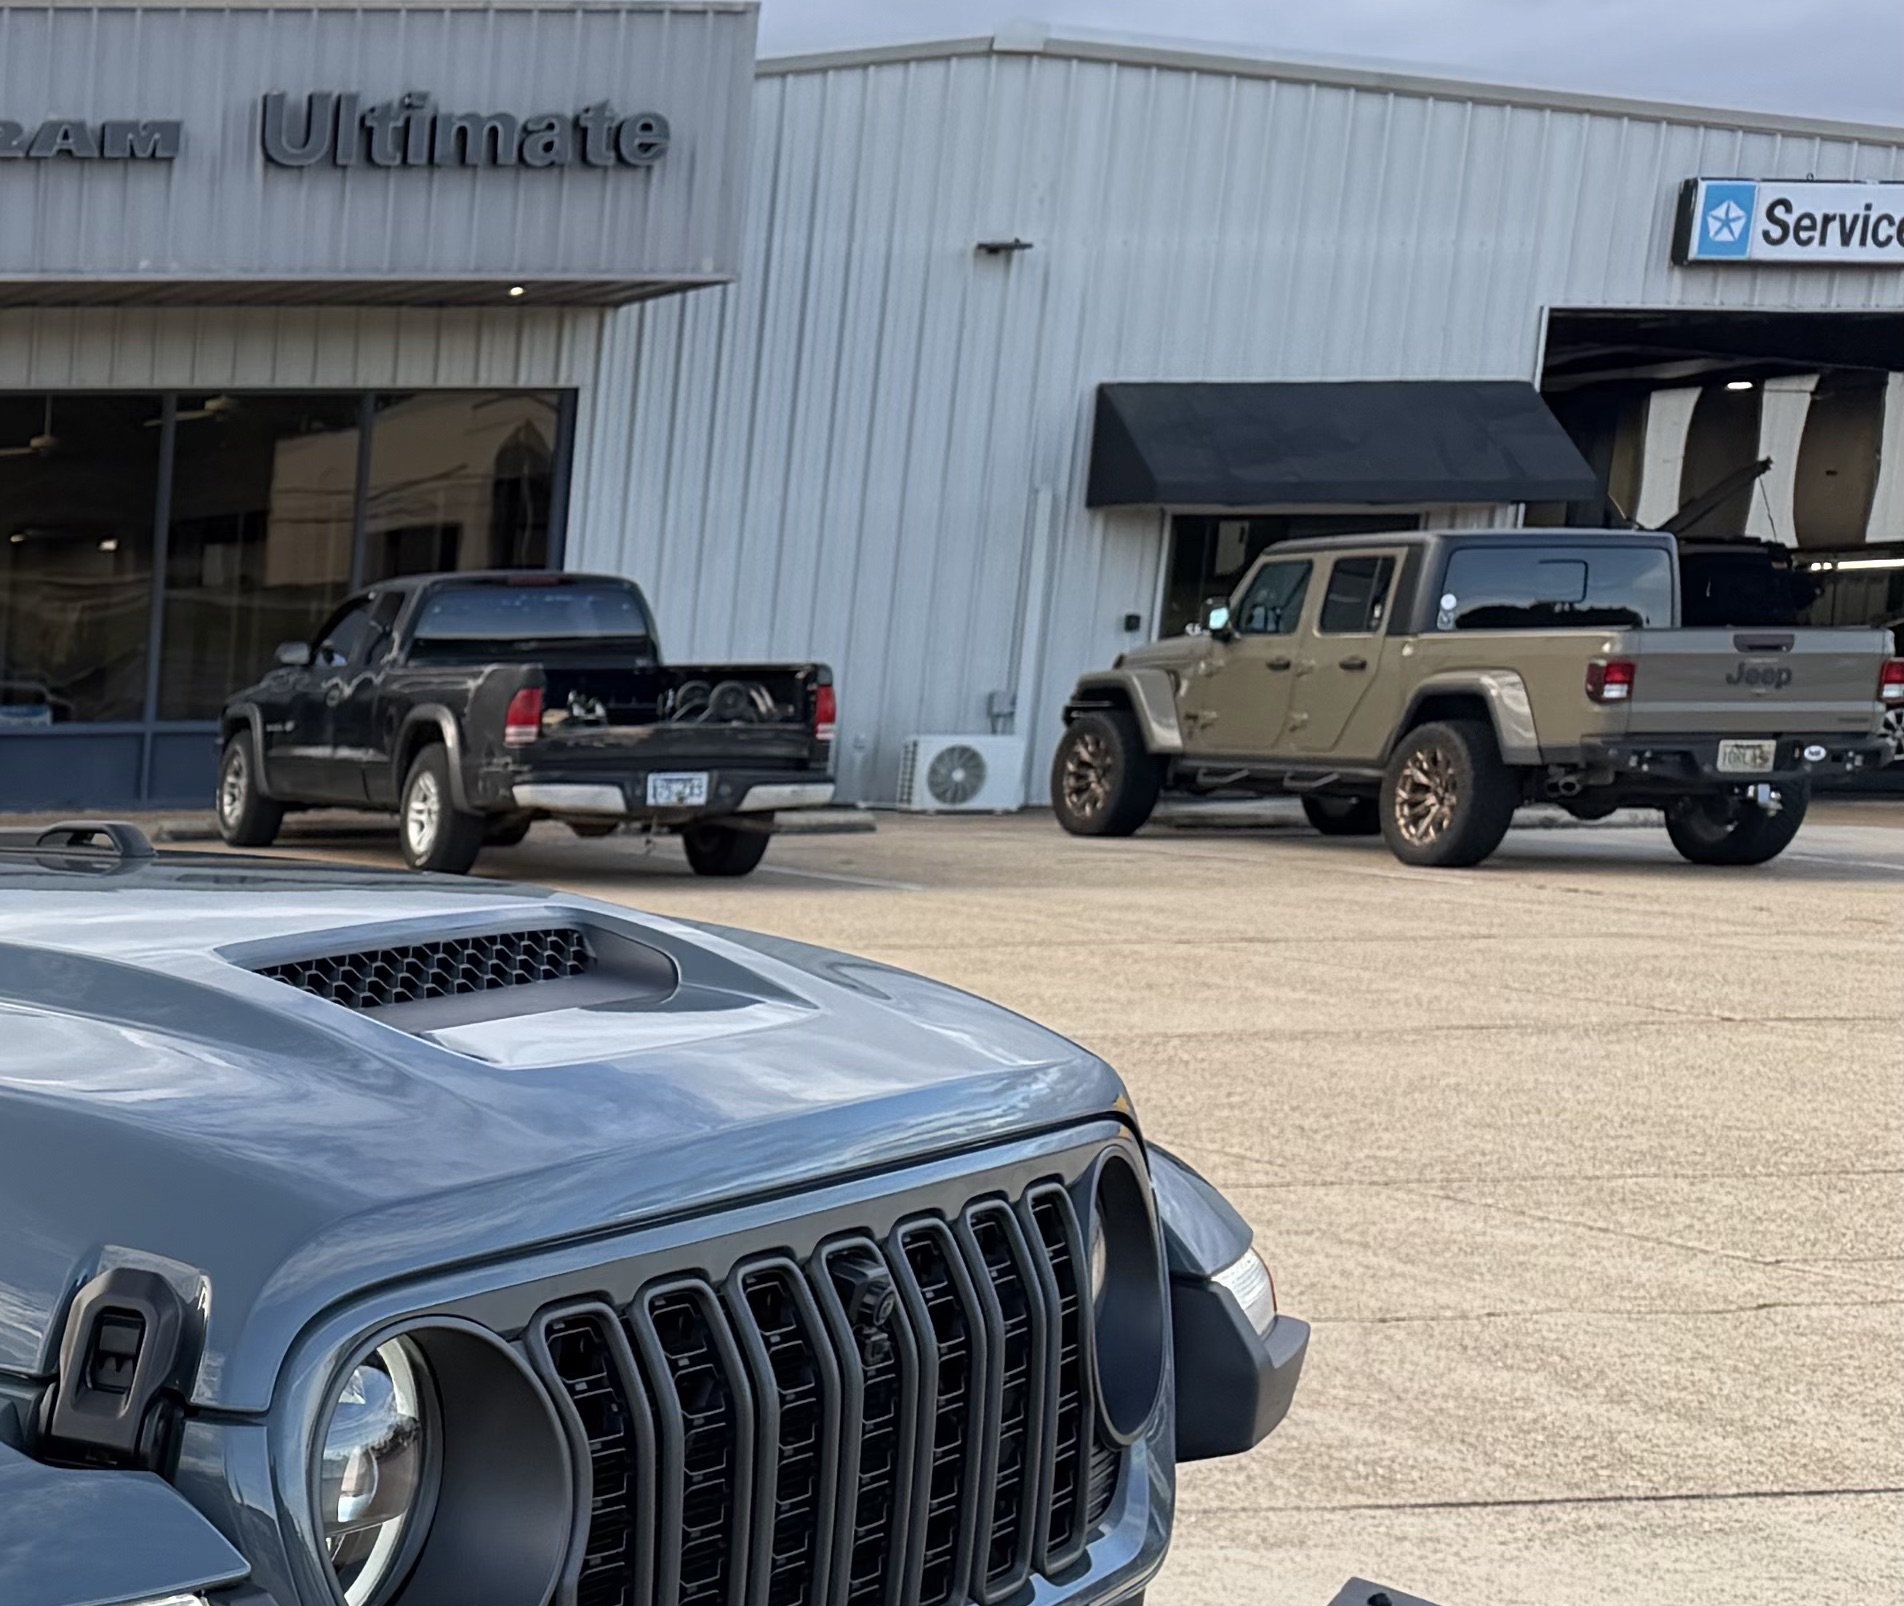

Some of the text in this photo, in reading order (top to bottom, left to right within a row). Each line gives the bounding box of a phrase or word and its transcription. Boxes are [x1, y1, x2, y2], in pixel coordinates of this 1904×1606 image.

[261, 91, 670, 170] Ultimate
[1762, 197, 1904, 248] Service
[1726, 661, 1792, 690] Jeep
